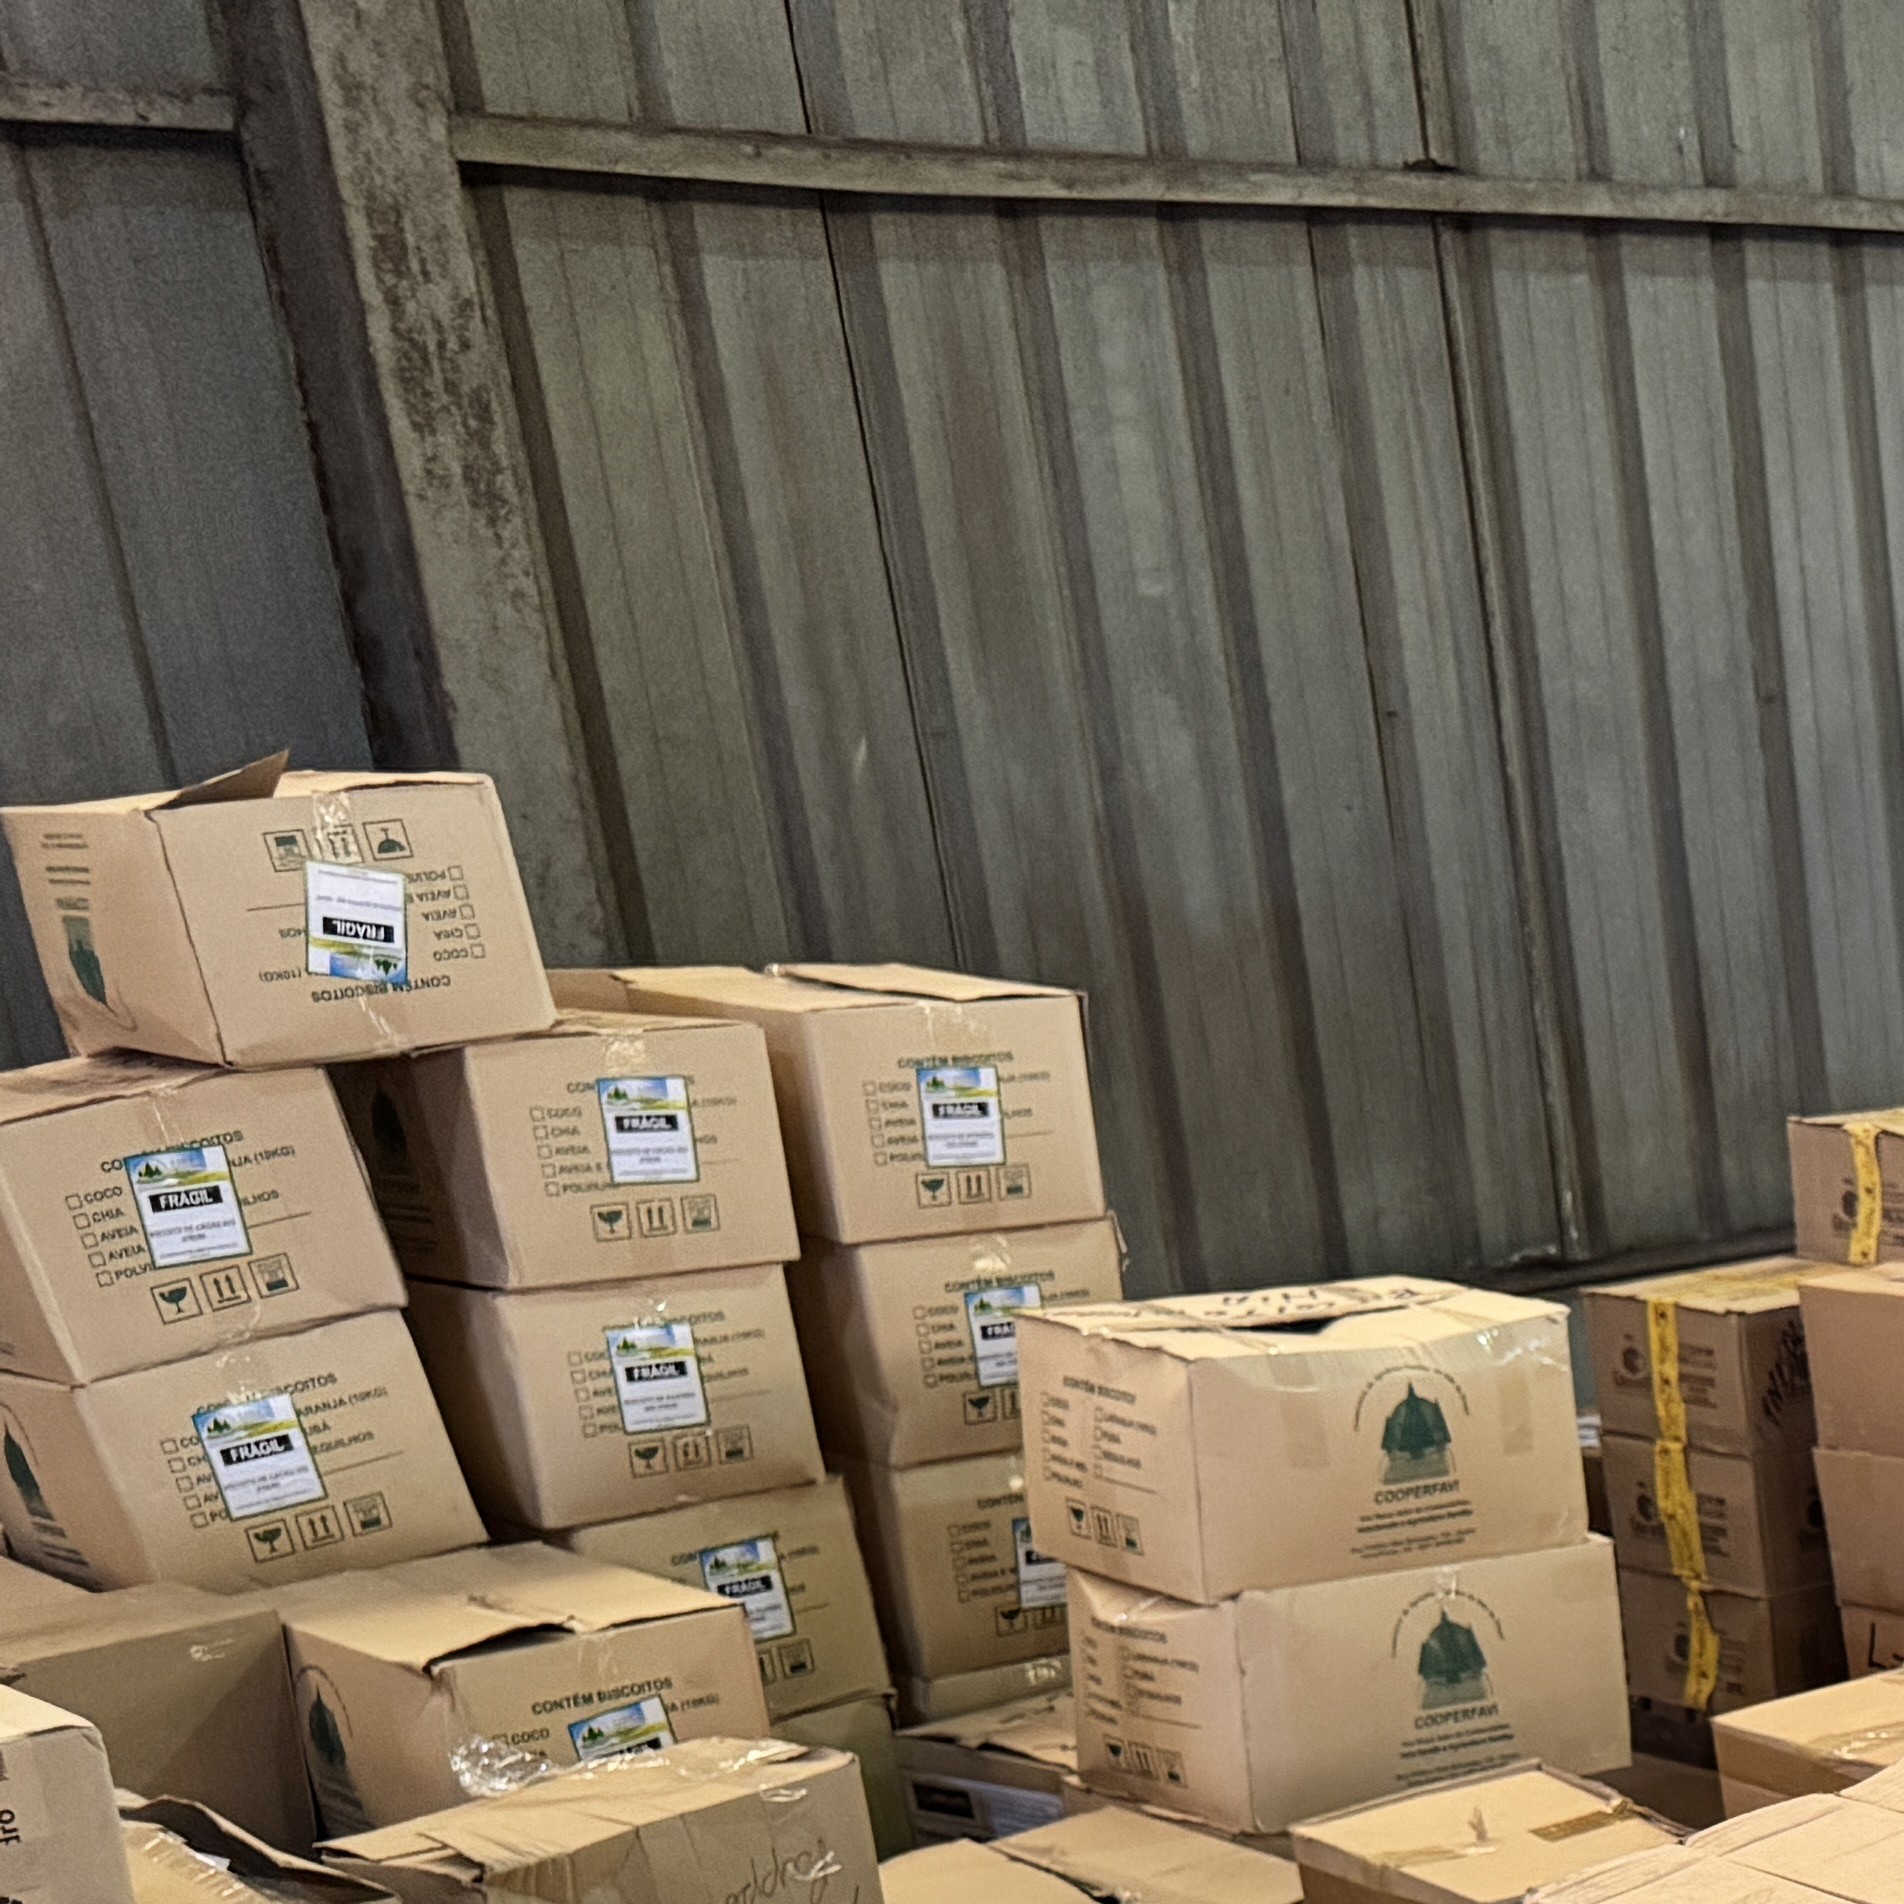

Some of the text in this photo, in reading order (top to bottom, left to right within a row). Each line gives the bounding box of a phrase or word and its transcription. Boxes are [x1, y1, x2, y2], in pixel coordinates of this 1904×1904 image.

[82, 1186, 123, 1204] COCO
[159, 1186, 214, 1211] FRÁGIL
[99, 1225, 140, 1243] AVEIA
[1374, 1479, 1461, 1506] COOPERFAVI
